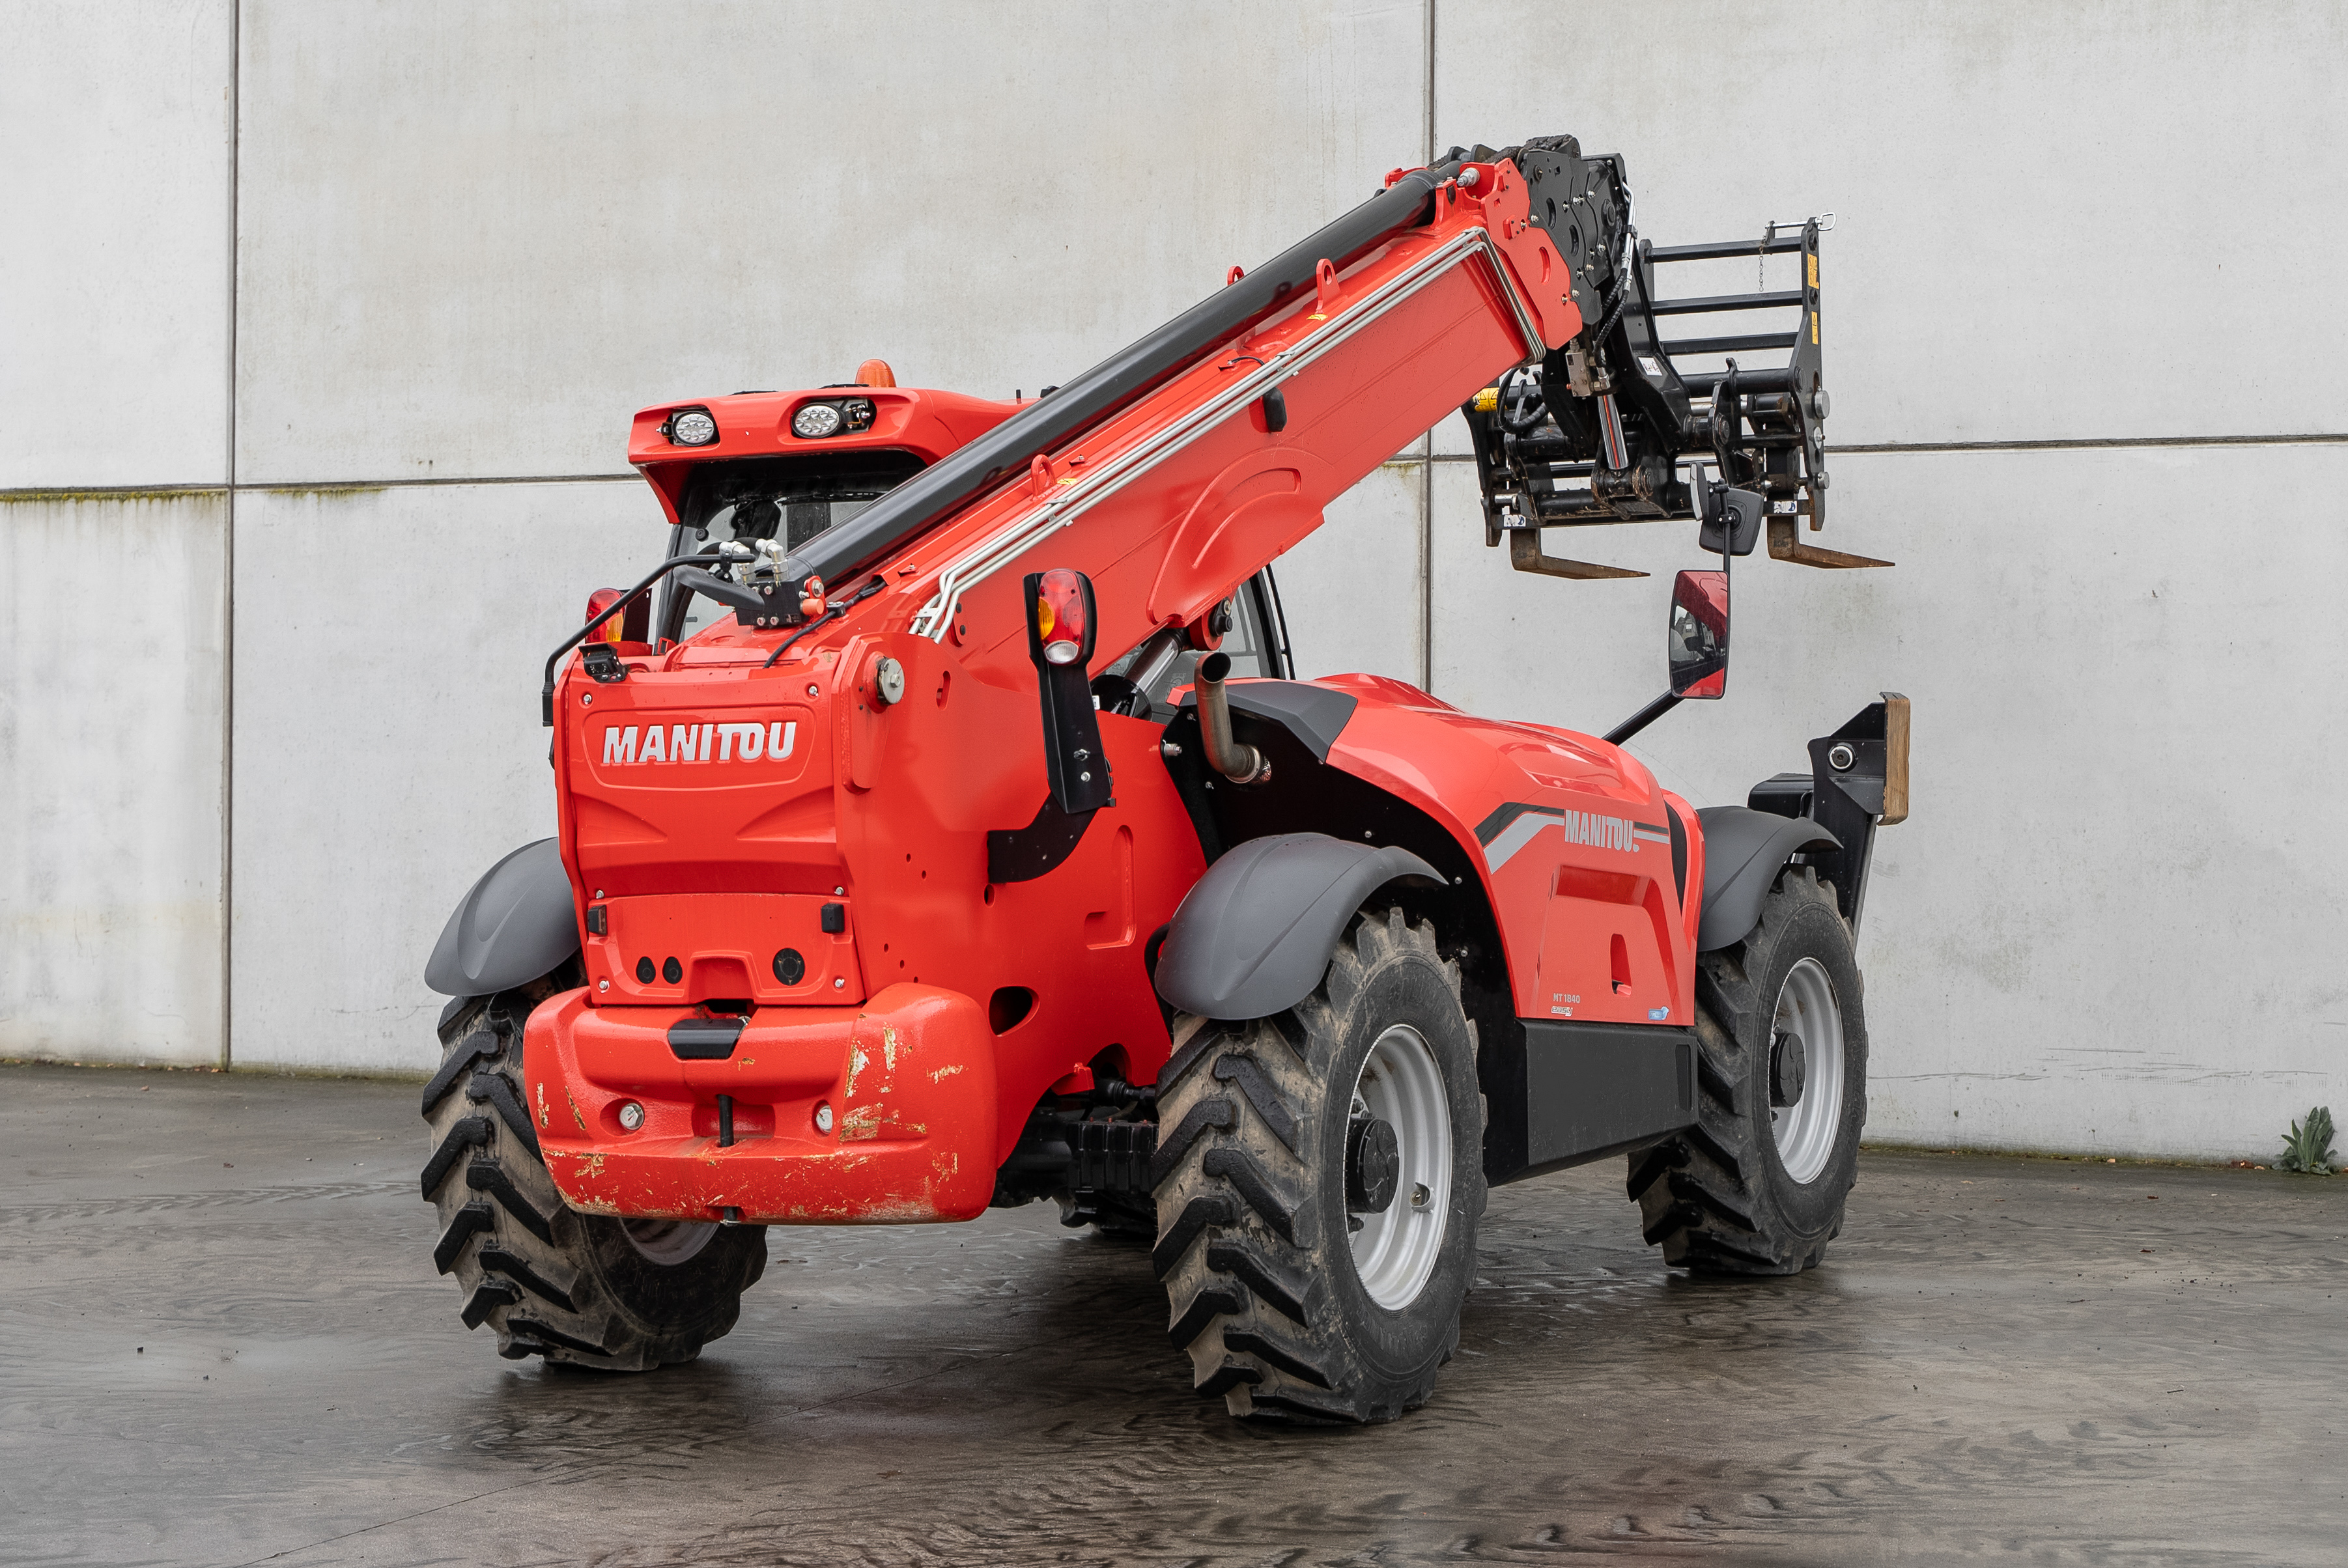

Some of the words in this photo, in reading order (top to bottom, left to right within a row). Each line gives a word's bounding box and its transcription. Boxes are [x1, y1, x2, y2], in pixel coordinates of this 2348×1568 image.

[602, 721, 797, 764] MANITOU
[1553, 992, 1563, 1002] MT
[1564, 994, 1581, 1003] 1840
[1551, 1005, 1574, 1017] easy
